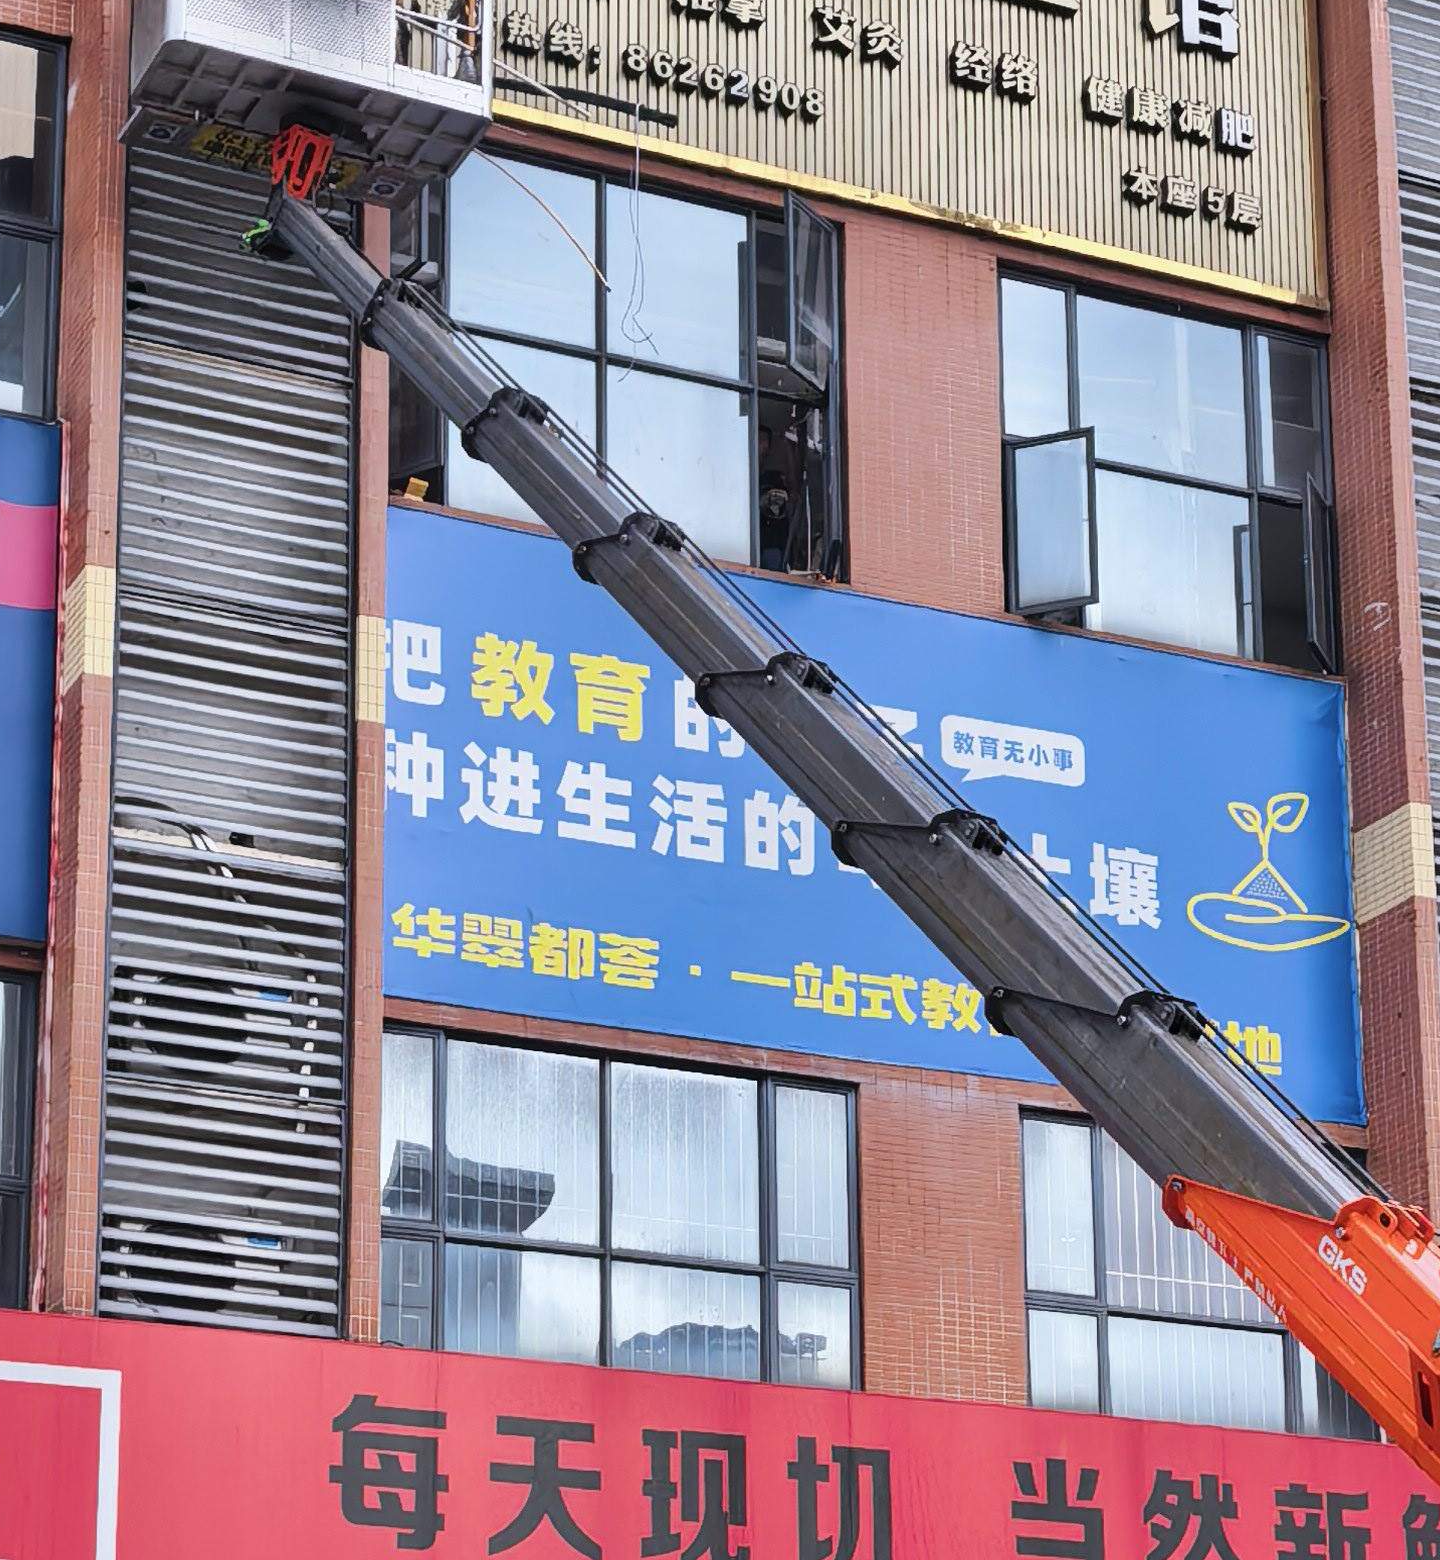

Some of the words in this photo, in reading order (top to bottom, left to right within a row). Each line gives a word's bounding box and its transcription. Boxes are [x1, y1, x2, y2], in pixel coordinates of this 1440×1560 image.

[815, 6, 904, 66] 艾灸
[954, 41, 1039, 102] 经络
[1086, 75, 1256, 156] 健康减肥
[1123, 166, 1263, 232] 本座5层
[951, 730, 1073, 773] 教育无小事
[1317, 1233, 1369, 1297] GKS
